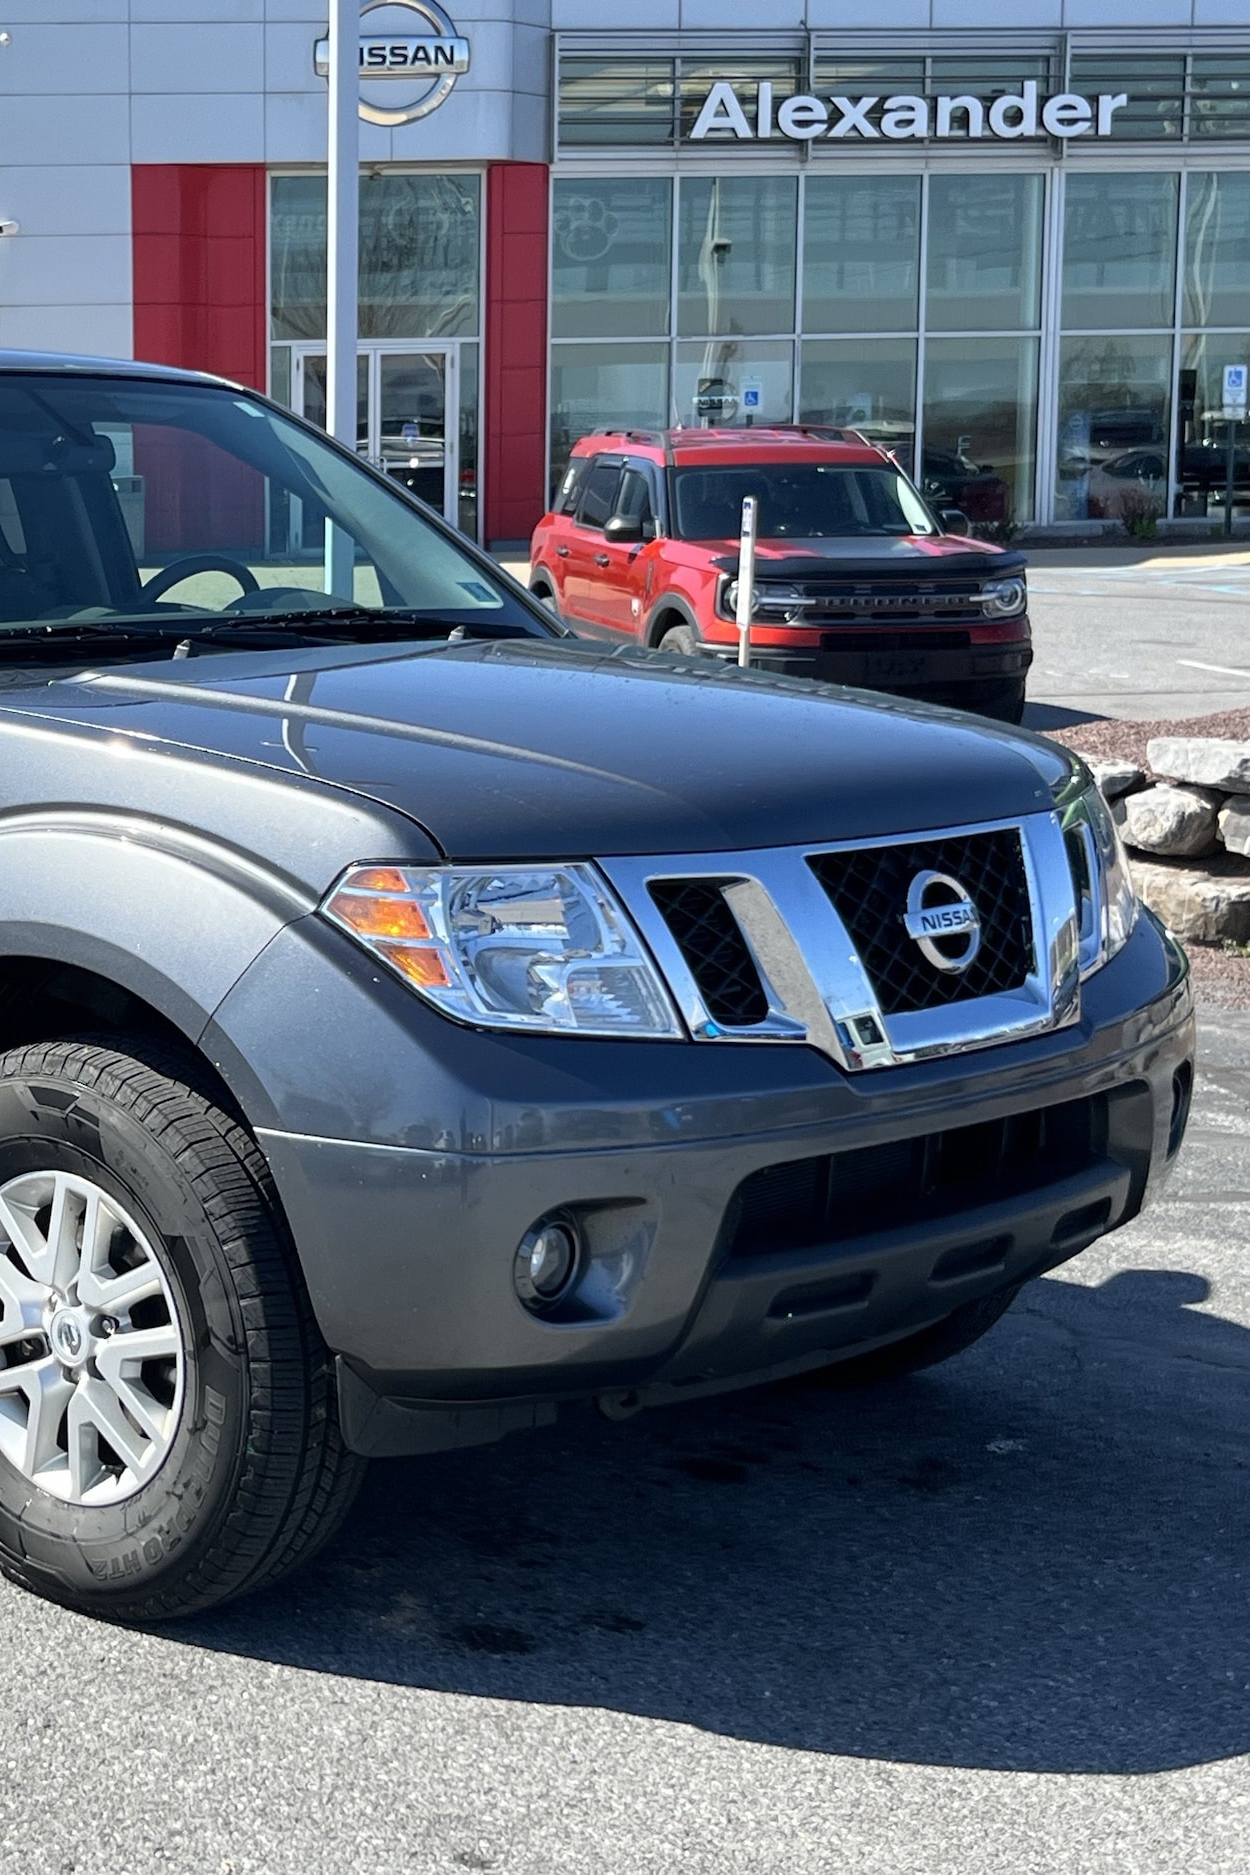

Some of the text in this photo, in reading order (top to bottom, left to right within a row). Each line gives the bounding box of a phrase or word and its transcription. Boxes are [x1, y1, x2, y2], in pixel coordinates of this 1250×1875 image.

[359, 45, 454, 66] ISSAN
[689, 80, 1127, 140] Alexander
[92, 1549, 142, 1581] HT2
